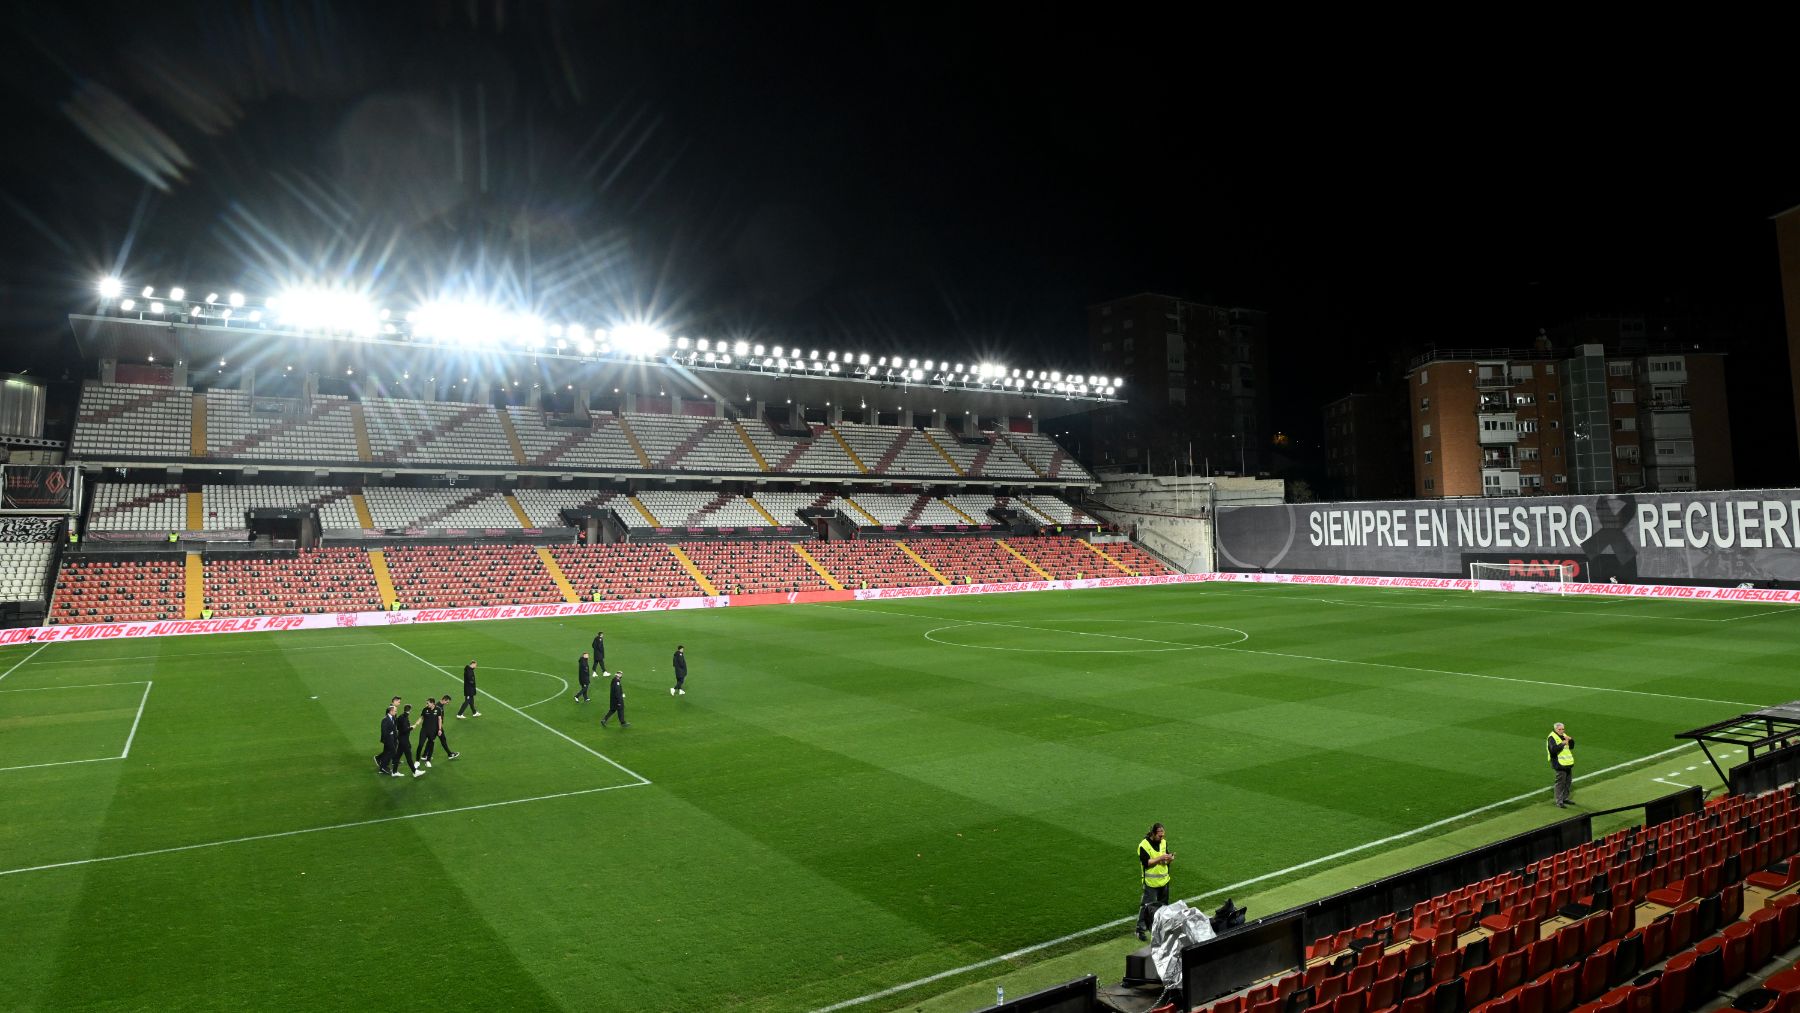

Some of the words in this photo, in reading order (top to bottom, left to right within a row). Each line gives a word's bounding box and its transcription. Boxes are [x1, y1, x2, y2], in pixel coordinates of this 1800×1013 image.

[1309, 509, 1409, 547] SIEMPRE
[1415, 508, 1448, 547] EN
[1457, 504, 1593, 548] NUESTRO
[1508, 559, 1581, 577] RAYO
[1146, 575, 1169, 584] PUNTOS
[1176, 573, 1215, 583] AUTOESCUELAS
[1218, 573, 1237, 581] Rayo
[1349, 576, 1378, 585] PUNTOS
[1389, 577, 1450, 588] AUTOESCUELAS
[932, 586, 941, 595] de
[942, 585, 970, 595] PUNTOS
[970, 585, 980, 593] en
[979, 582, 1028, 593] AUTOESCUELAS
[1030, 582, 1049, 591] Rayo
[1634, 585, 1647, 595] de
[1650, 586, 1696, 597] PUNTOS
[1695, 589, 1711, 598] en
[1713, 588, 1800, 602] AUTOESCUELA
[501, 608, 517, 618] de
[517, 604, 560, 617] PUNTOS
[559, 605, 574, 615] en
[574, 599, 651, 615] AUTOESCUELAS
[652, 598, 680, 610] Rayo
[37, 628, 60, 641] de
[61, 624, 127, 640] PUNTOS
[126, 626, 148, 636] en
[148, 618, 262, 635] AUTOESCUELAS
[263, 616, 304, 631] Rayo
